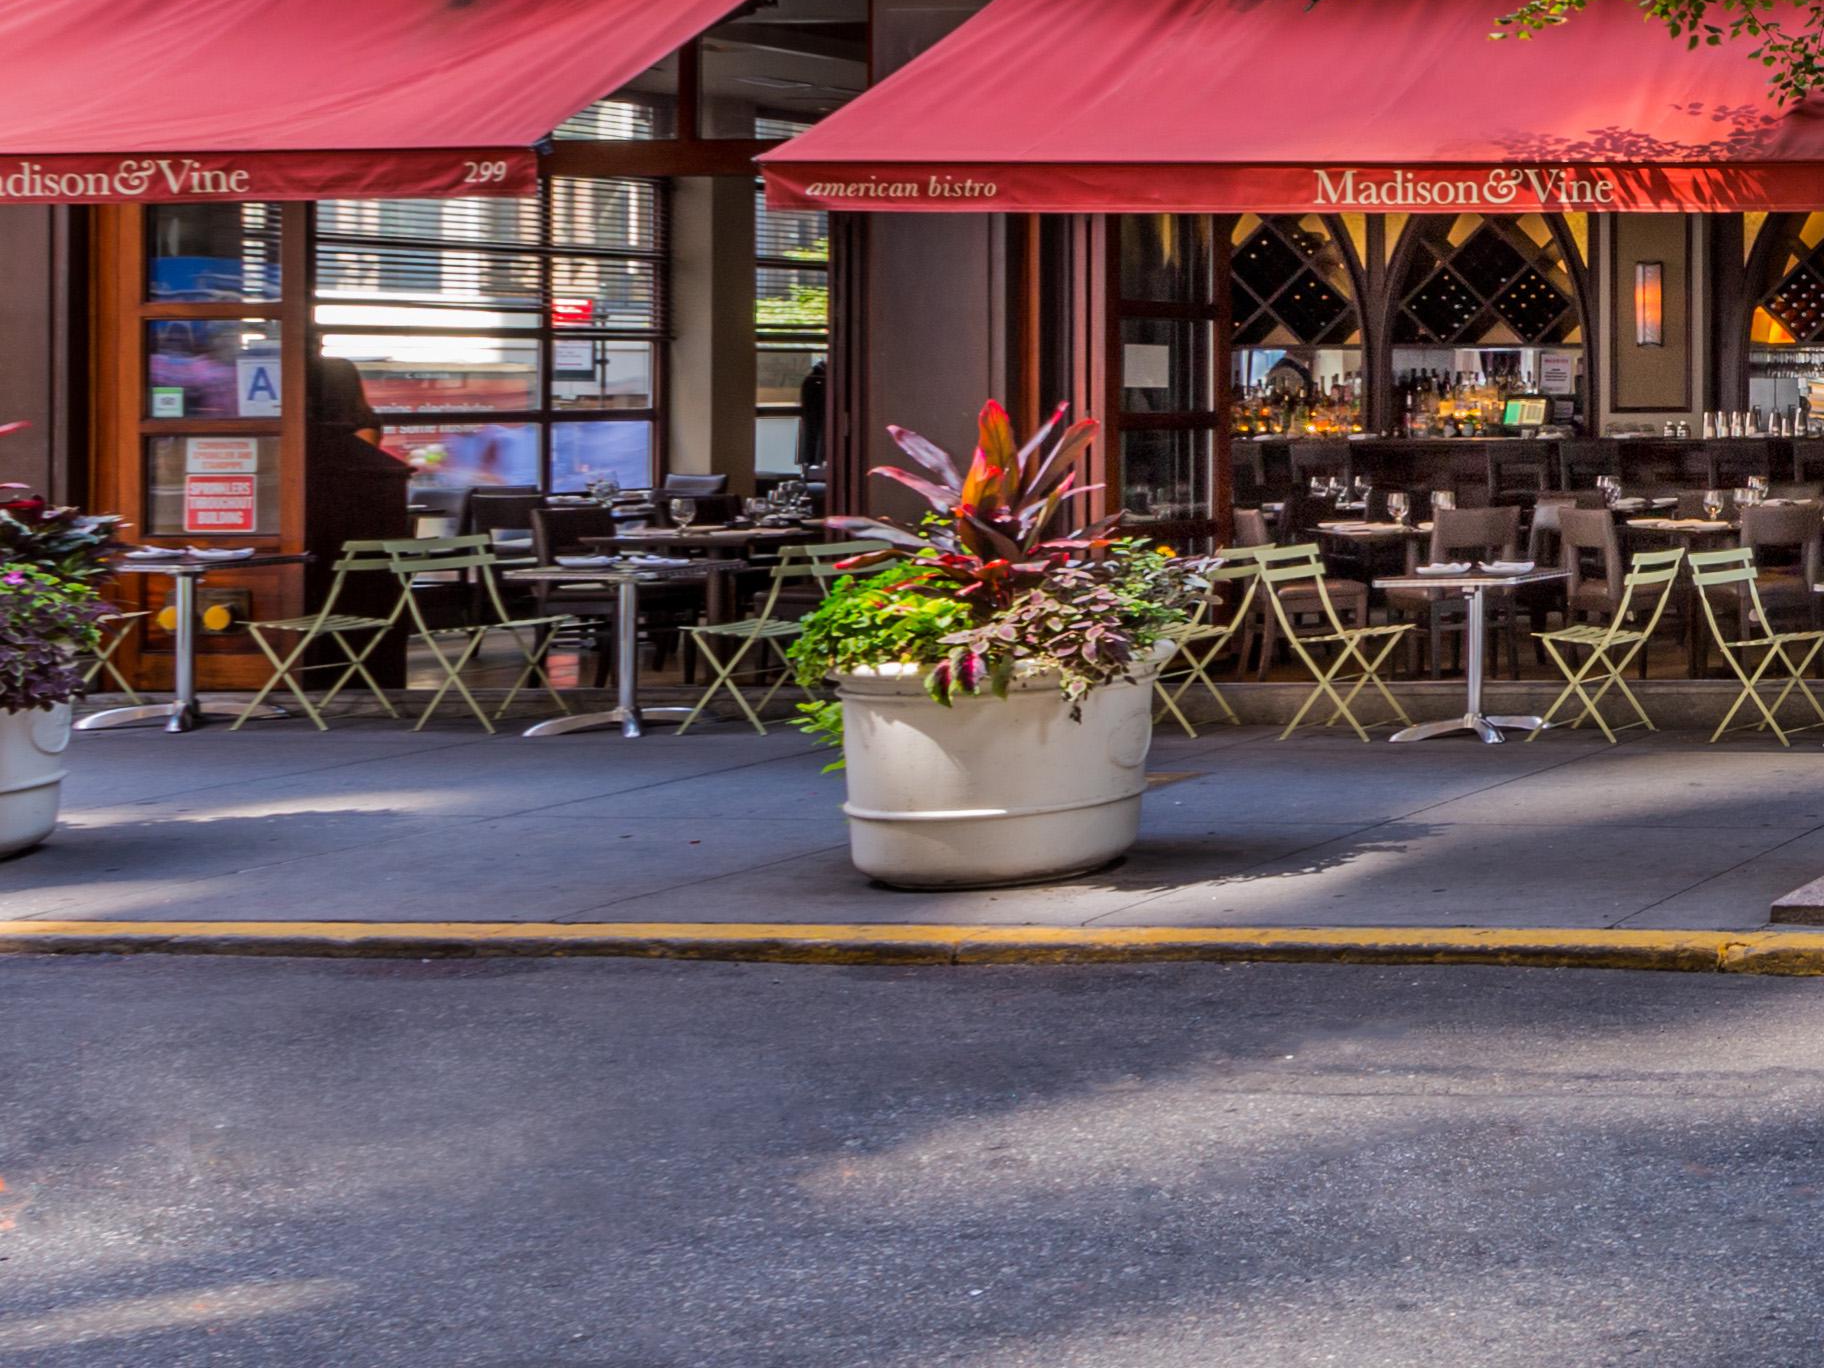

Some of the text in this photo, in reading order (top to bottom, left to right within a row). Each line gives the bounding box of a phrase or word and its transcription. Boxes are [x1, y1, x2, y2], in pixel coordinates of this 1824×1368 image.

[0, 159, 250, 198] dison&Vine
[463, 160, 507, 184] 299
[805, 175, 998, 198] american bistro
[247, 366, 278, 401] A
